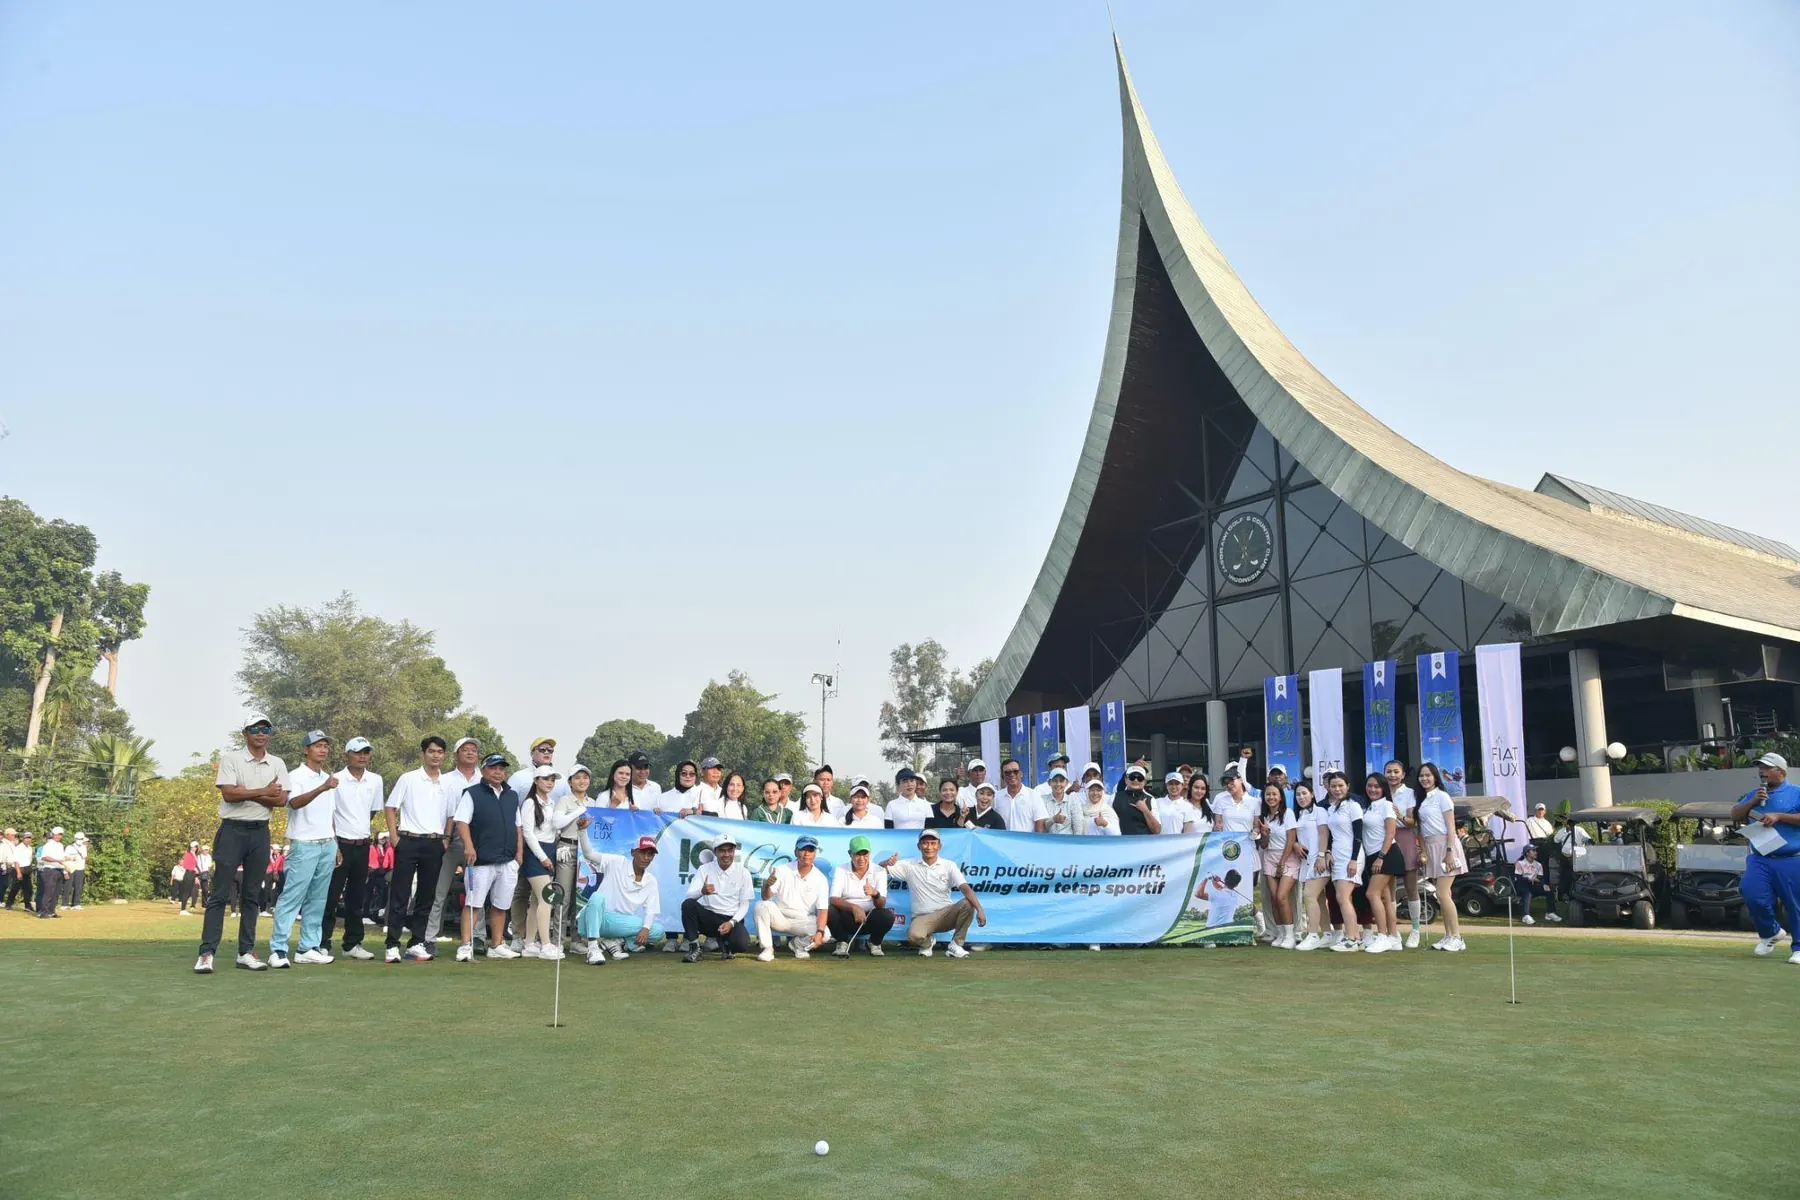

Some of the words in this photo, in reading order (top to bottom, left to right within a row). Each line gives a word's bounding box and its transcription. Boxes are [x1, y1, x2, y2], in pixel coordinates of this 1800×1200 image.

[1491, 746, 1518, 761] FIAT
[1492, 762, 1520, 777] LUX
[594, 822, 614, 832] FIAT
[593, 831, 613, 840] LUX
[960, 861, 990, 877] kan
[994, 863, 1057, 881] puding
[1061, 864, 1079, 878] di
[1083, 864, 1134, 878] dalam
[1138, 864, 1166, 880] lift,
[1016, 881, 1049, 894] dan
[1053, 881, 1101, 897] tetap
[1104, 881, 1167, 897] sportif
[547, 892, 556, 903] 4
